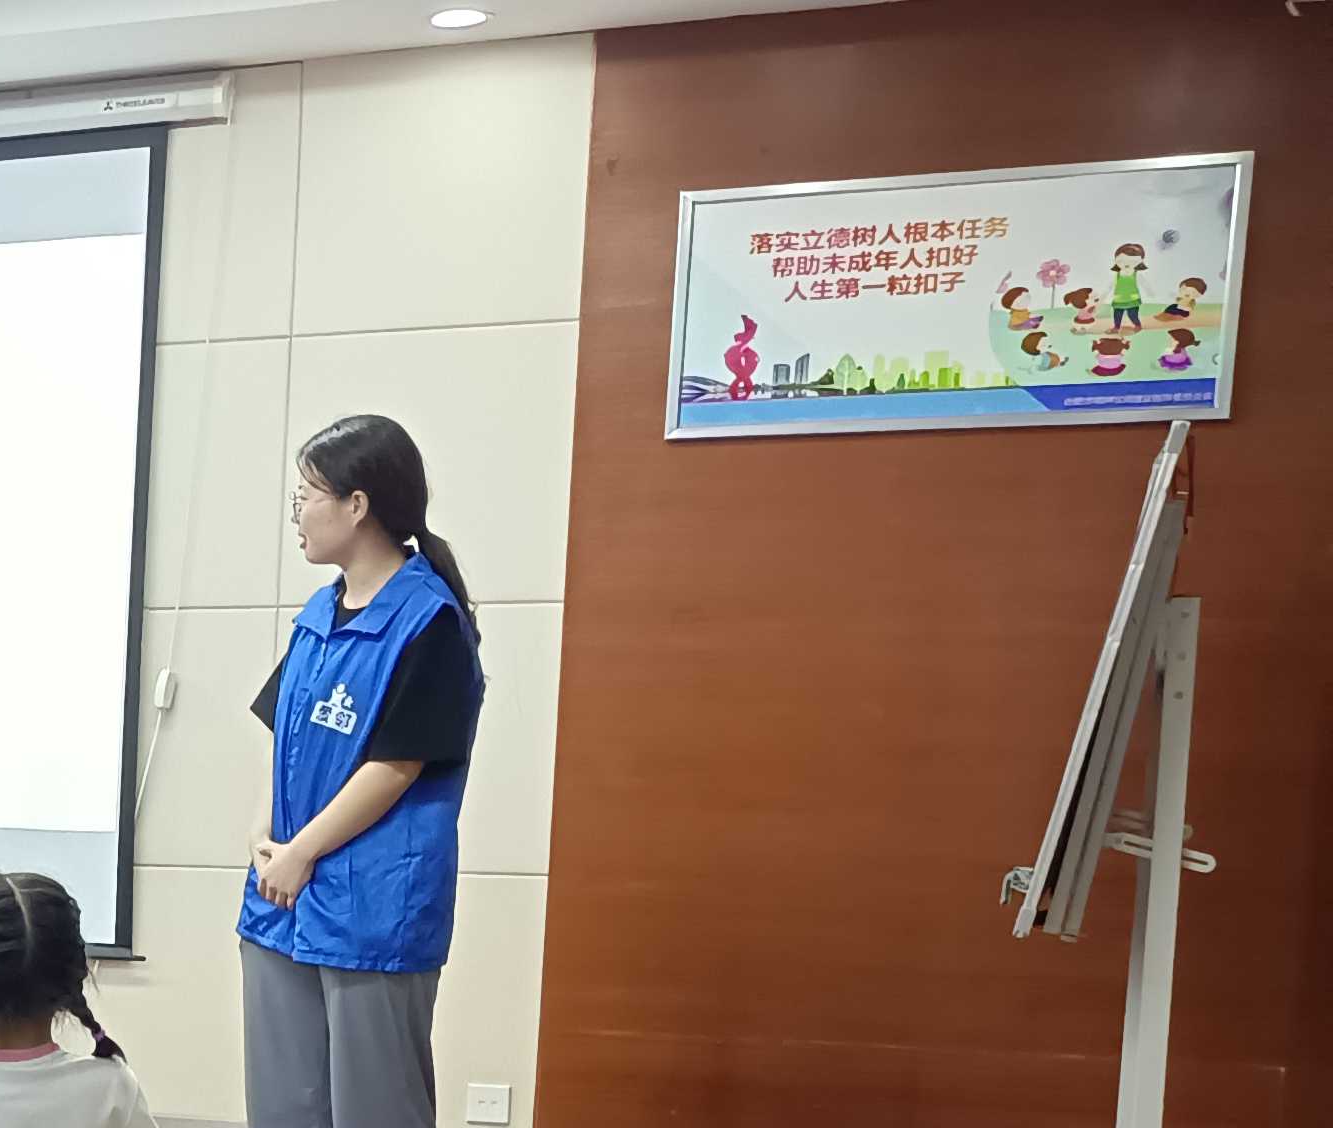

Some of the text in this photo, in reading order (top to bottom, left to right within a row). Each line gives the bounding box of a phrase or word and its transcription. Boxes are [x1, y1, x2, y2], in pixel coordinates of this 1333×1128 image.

[749, 216, 1010, 255] 落实立德树人根本任务
[771, 244, 980, 278] 帮助未成年人扣好
[784, 271, 966, 303] 人生第一粒扣子
